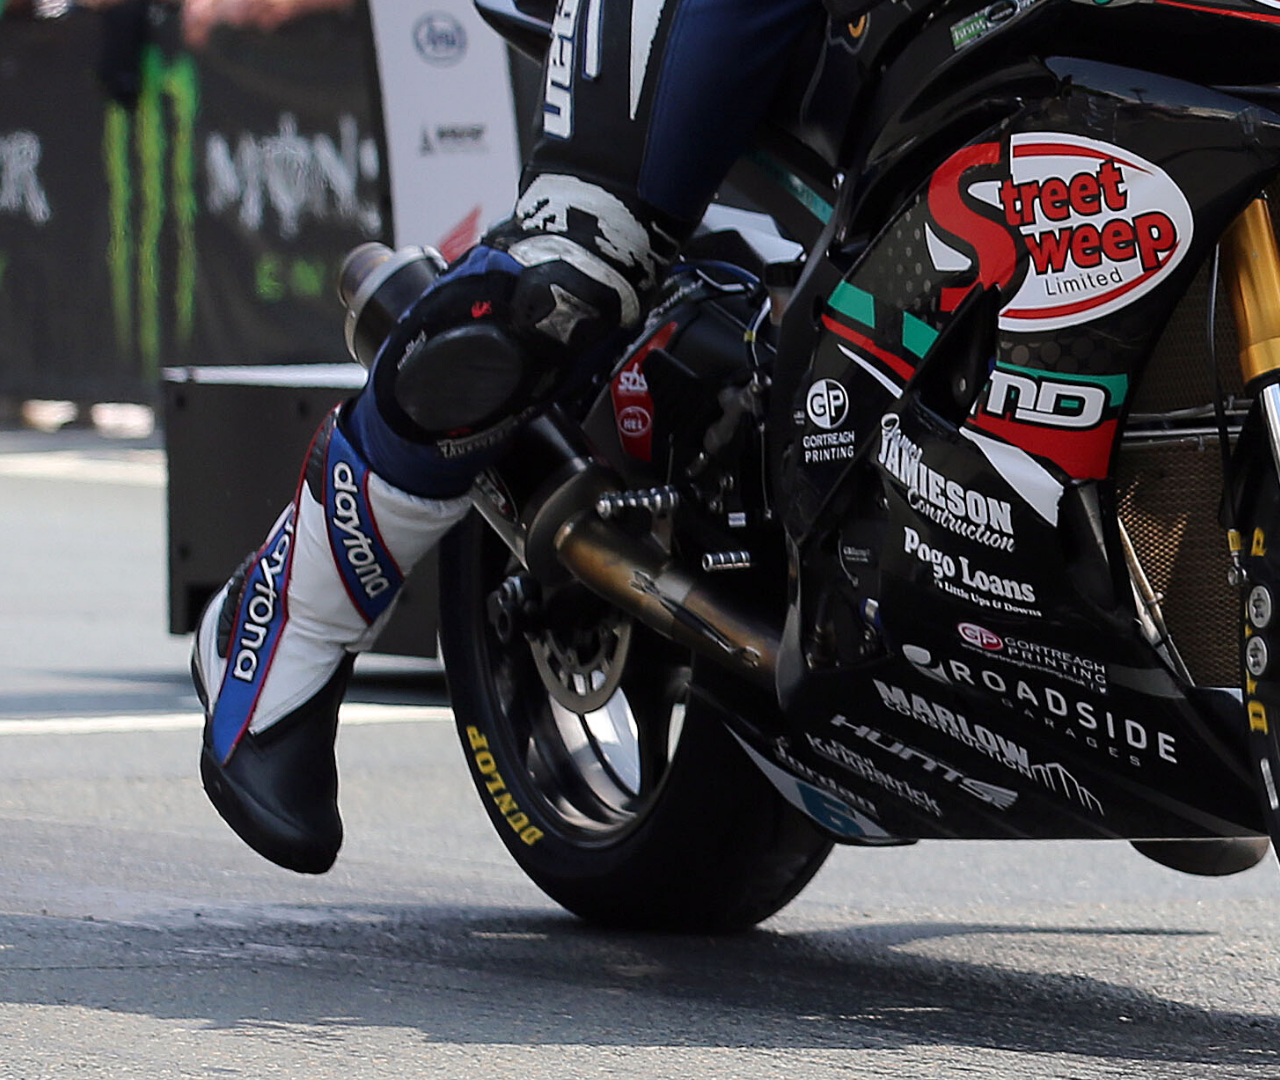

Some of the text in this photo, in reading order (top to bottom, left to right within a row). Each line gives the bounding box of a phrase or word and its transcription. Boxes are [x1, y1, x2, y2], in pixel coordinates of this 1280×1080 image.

[1045, 267, 1124, 296] Limited
[809, 384, 847, 420] GP
[802, 430, 856, 450] GORTREAGH
[804, 445, 855, 463] PRINTING
[878, 430, 1015, 536] JAMIESON
[333, 460, 391, 600] daytona
[906, 487, 1016, 554] Construction
[903, 525, 1037, 604] Pogo Loans
[962, 625, 1000, 648] GP
[1003, 601, 1043, 618] Downs
[1003, 636, 1107, 675] GORTREAGH
[1006, 646, 1107, 685] PRINTING
[872, 677, 1031, 769] MARLOW
[882, 698, 1034, 781] CONSTRUCTION
[948, 658, 1179, 765] ROADSIDE
[1000, 696, 1142, 768] GARAGES
[465, 724, 545, 846] DUNLOP
